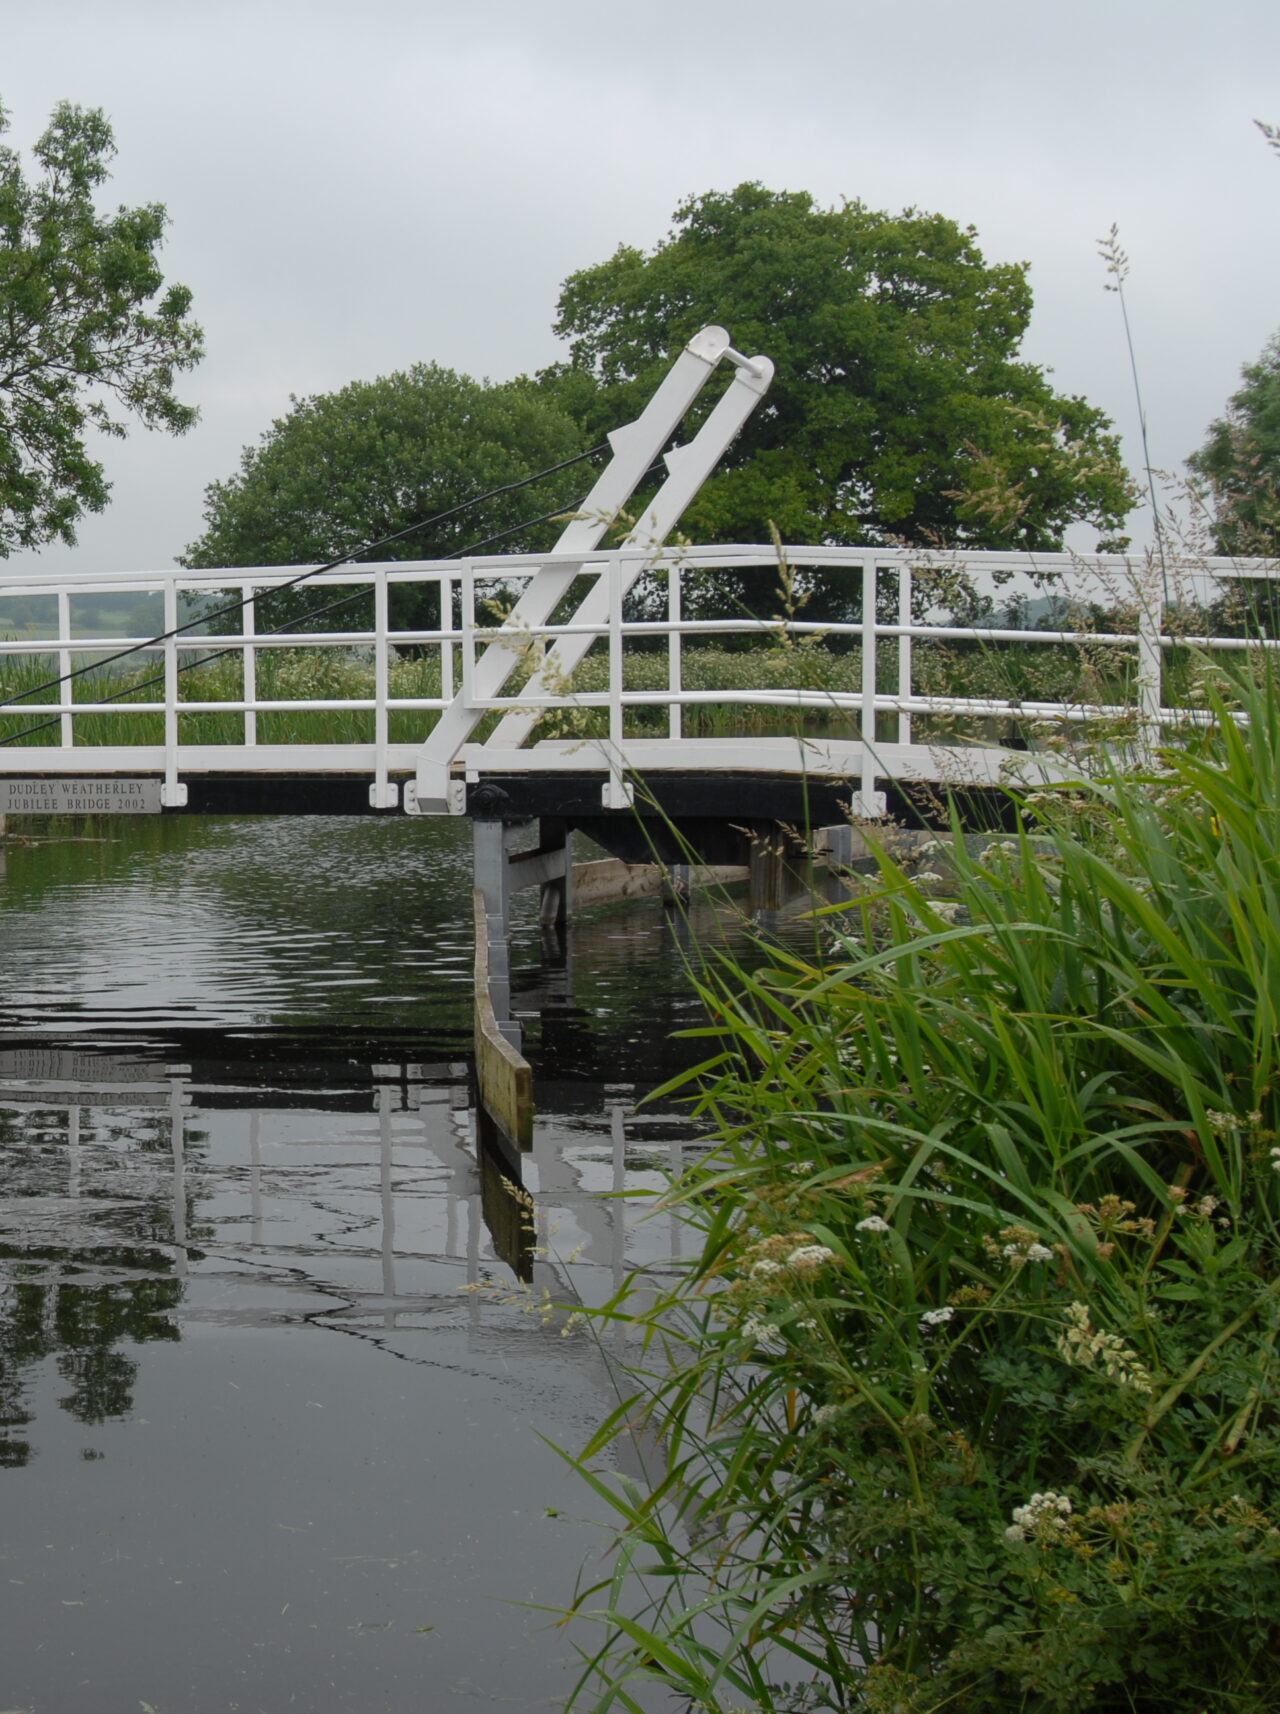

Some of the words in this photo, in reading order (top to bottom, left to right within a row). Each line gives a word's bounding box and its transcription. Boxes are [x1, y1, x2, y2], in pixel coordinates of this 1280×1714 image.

[9, 783, 55, 795] DUDLEY
[62, 783, 144, 795] WEATHERLEY
[7, 798, 58, 810] JUBILEE
[67, 798, 111, 810] BRIDGE
[118, 798, 145, 809] 2002
